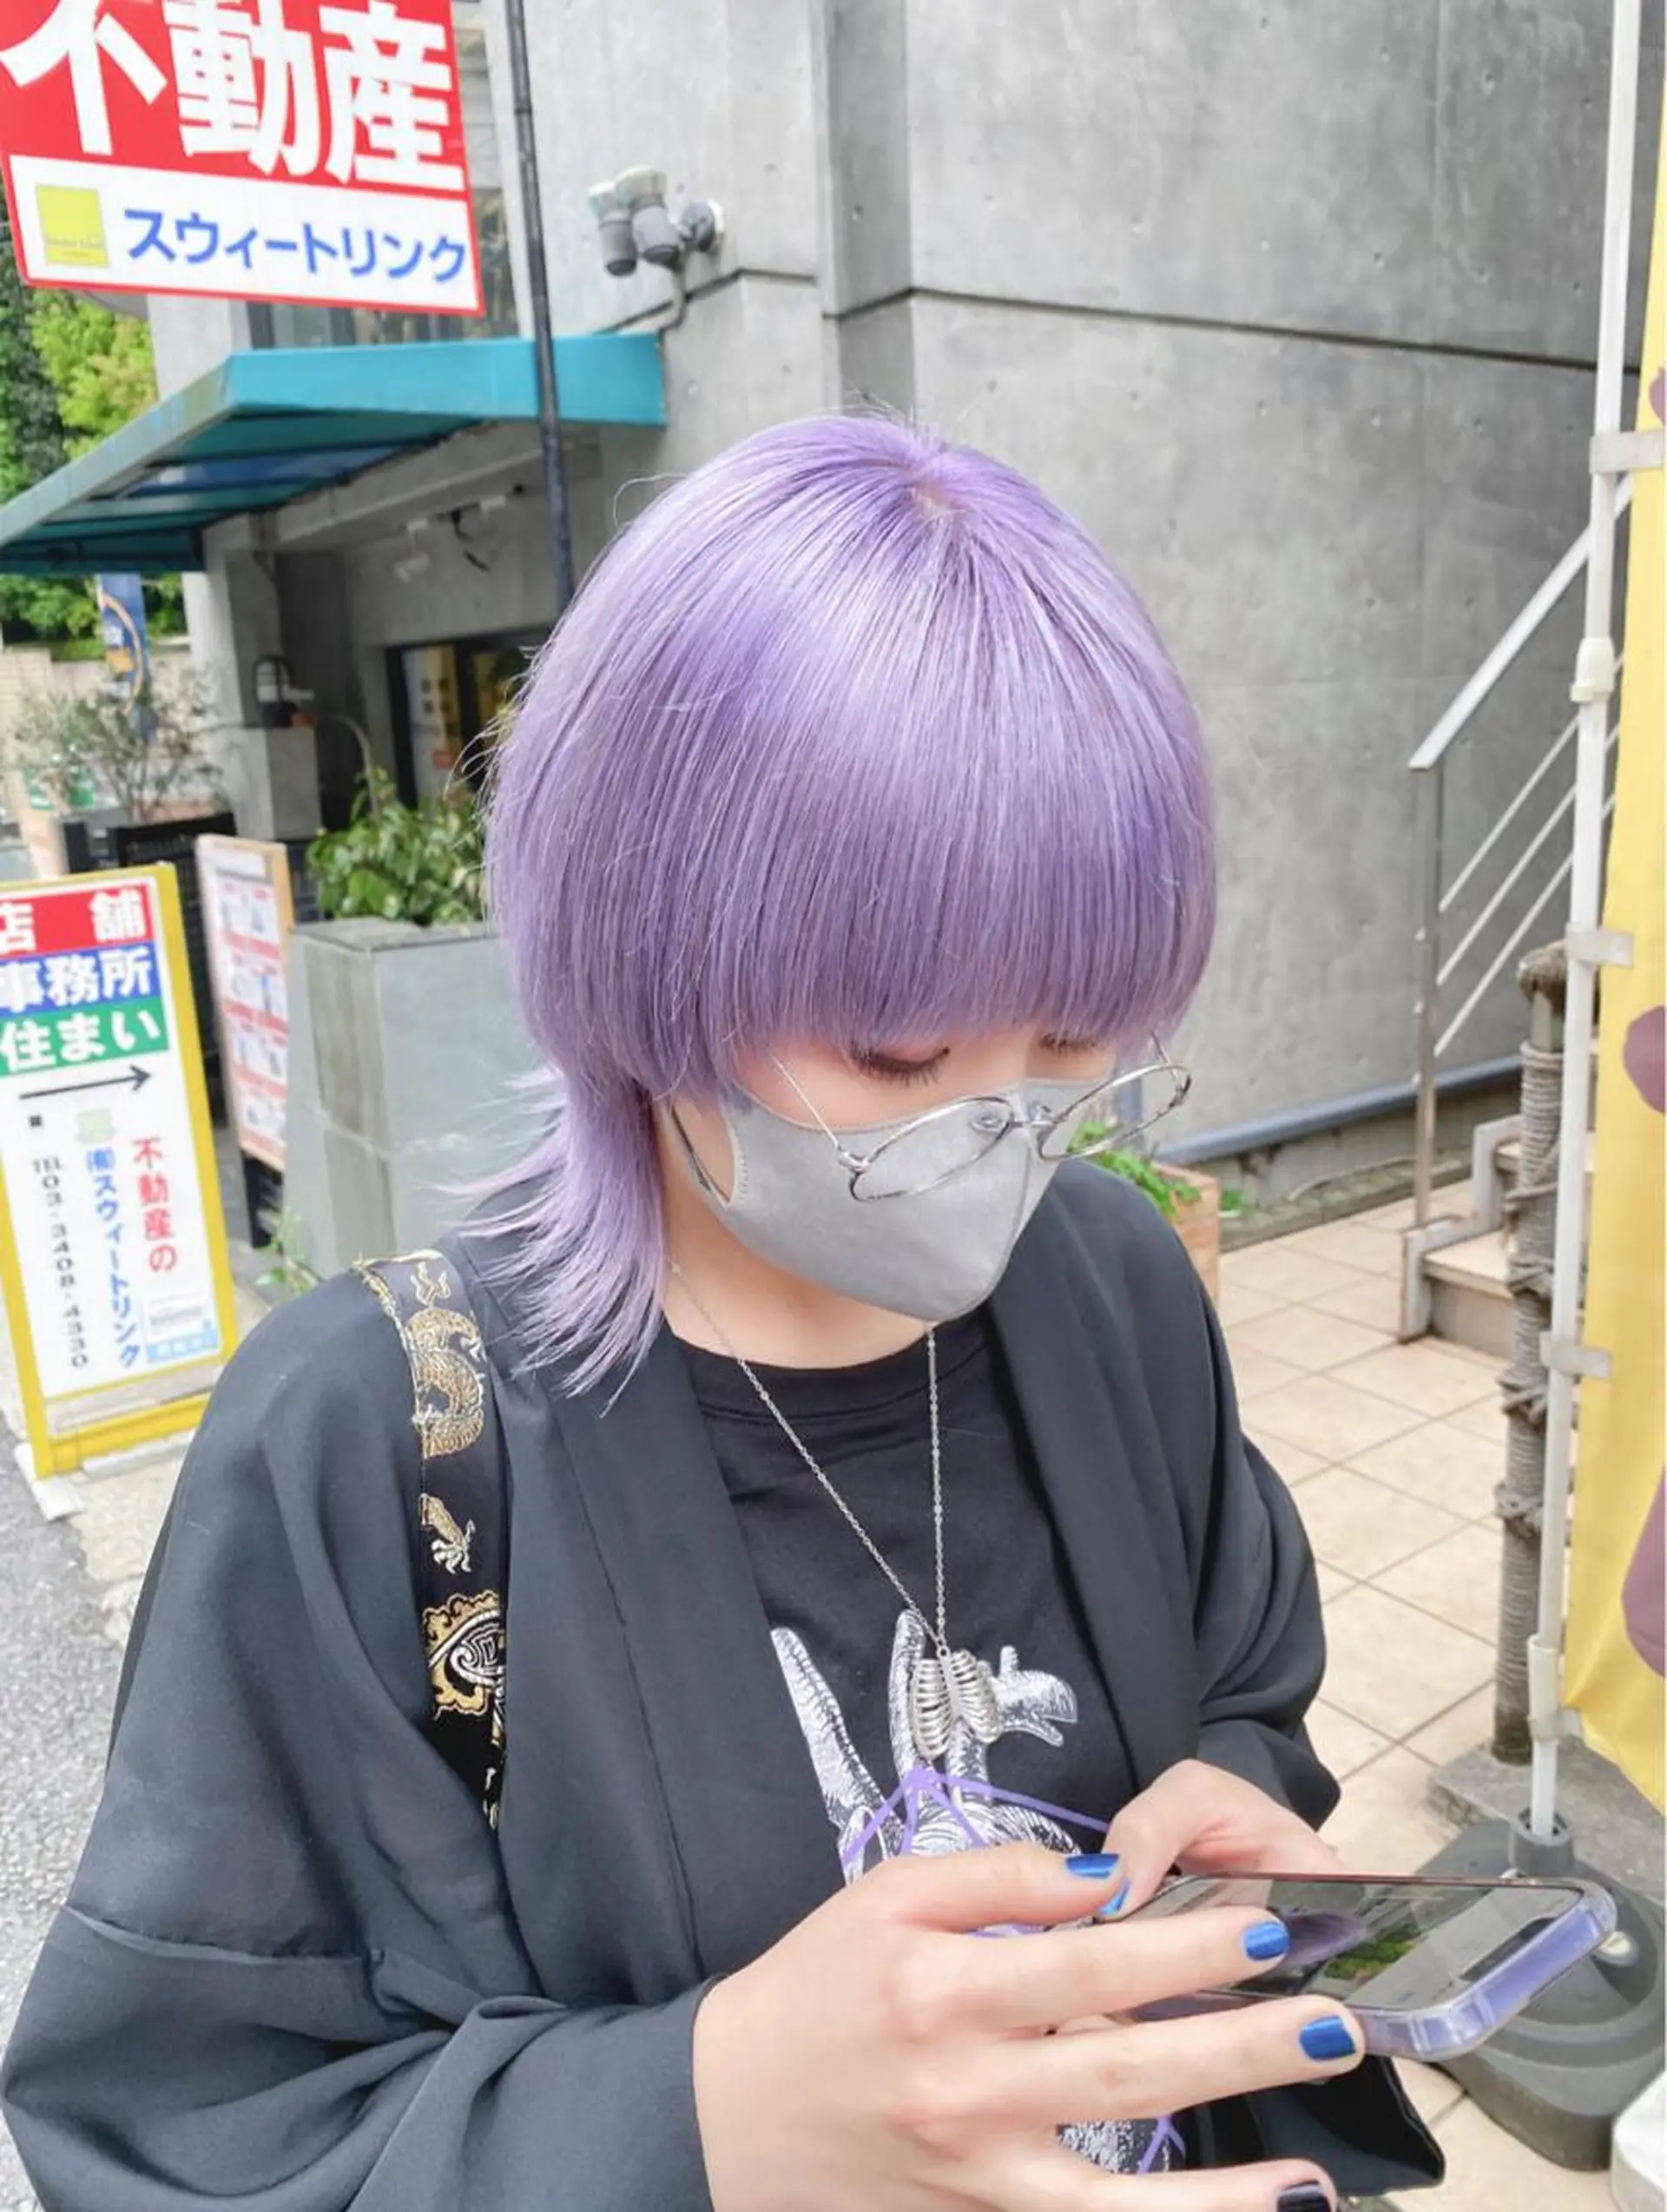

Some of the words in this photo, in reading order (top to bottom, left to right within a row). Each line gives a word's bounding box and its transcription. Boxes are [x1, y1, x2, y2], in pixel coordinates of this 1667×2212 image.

[0, 0, 465, 191] 不動産
[124, 208, 466, 283] スウィートリンク
[0, 947, 152, 1013] 事務所
[0, 1011, 160, 1073] 住まい
[132, 1136, 178, 1274] 不動産の
